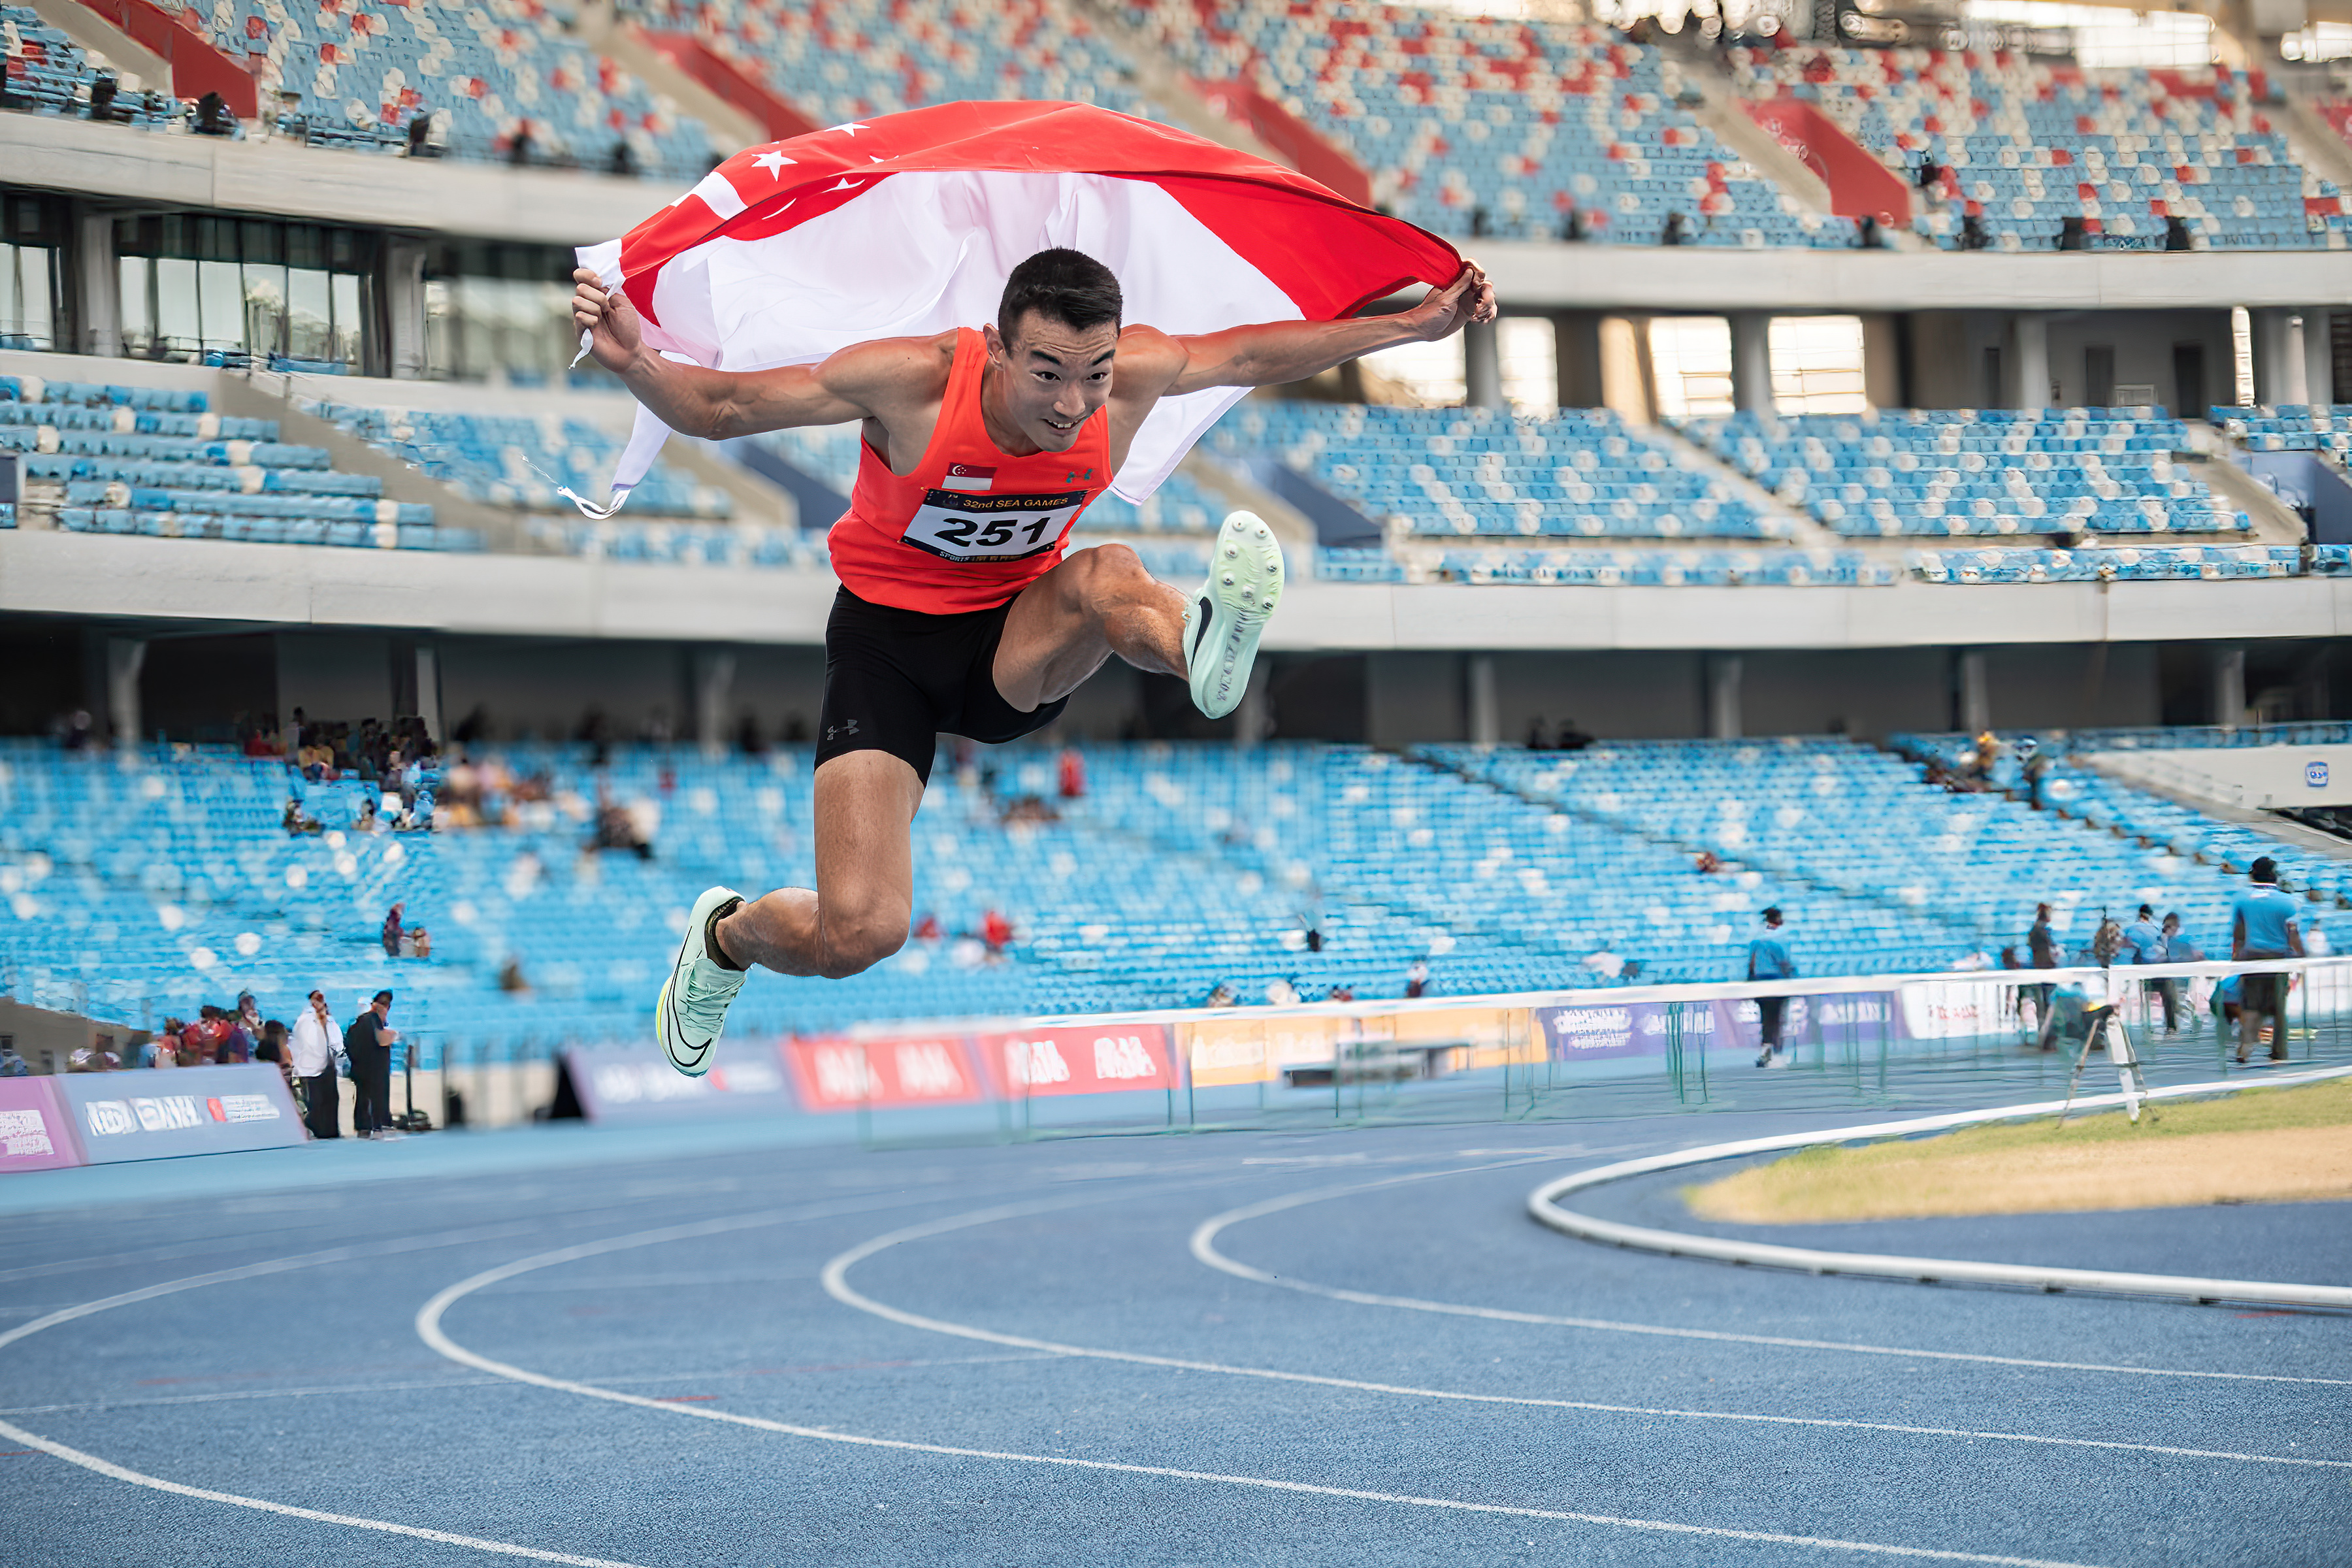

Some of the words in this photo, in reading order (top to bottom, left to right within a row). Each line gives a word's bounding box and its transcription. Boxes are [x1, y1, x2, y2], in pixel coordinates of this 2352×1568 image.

[963, 499, 993, 508] 32nd
[1024, 498, 1068, 506] GAMES
[934, 517, 1051, 547] 251
[939, 551, 970, 562] SPORTS
